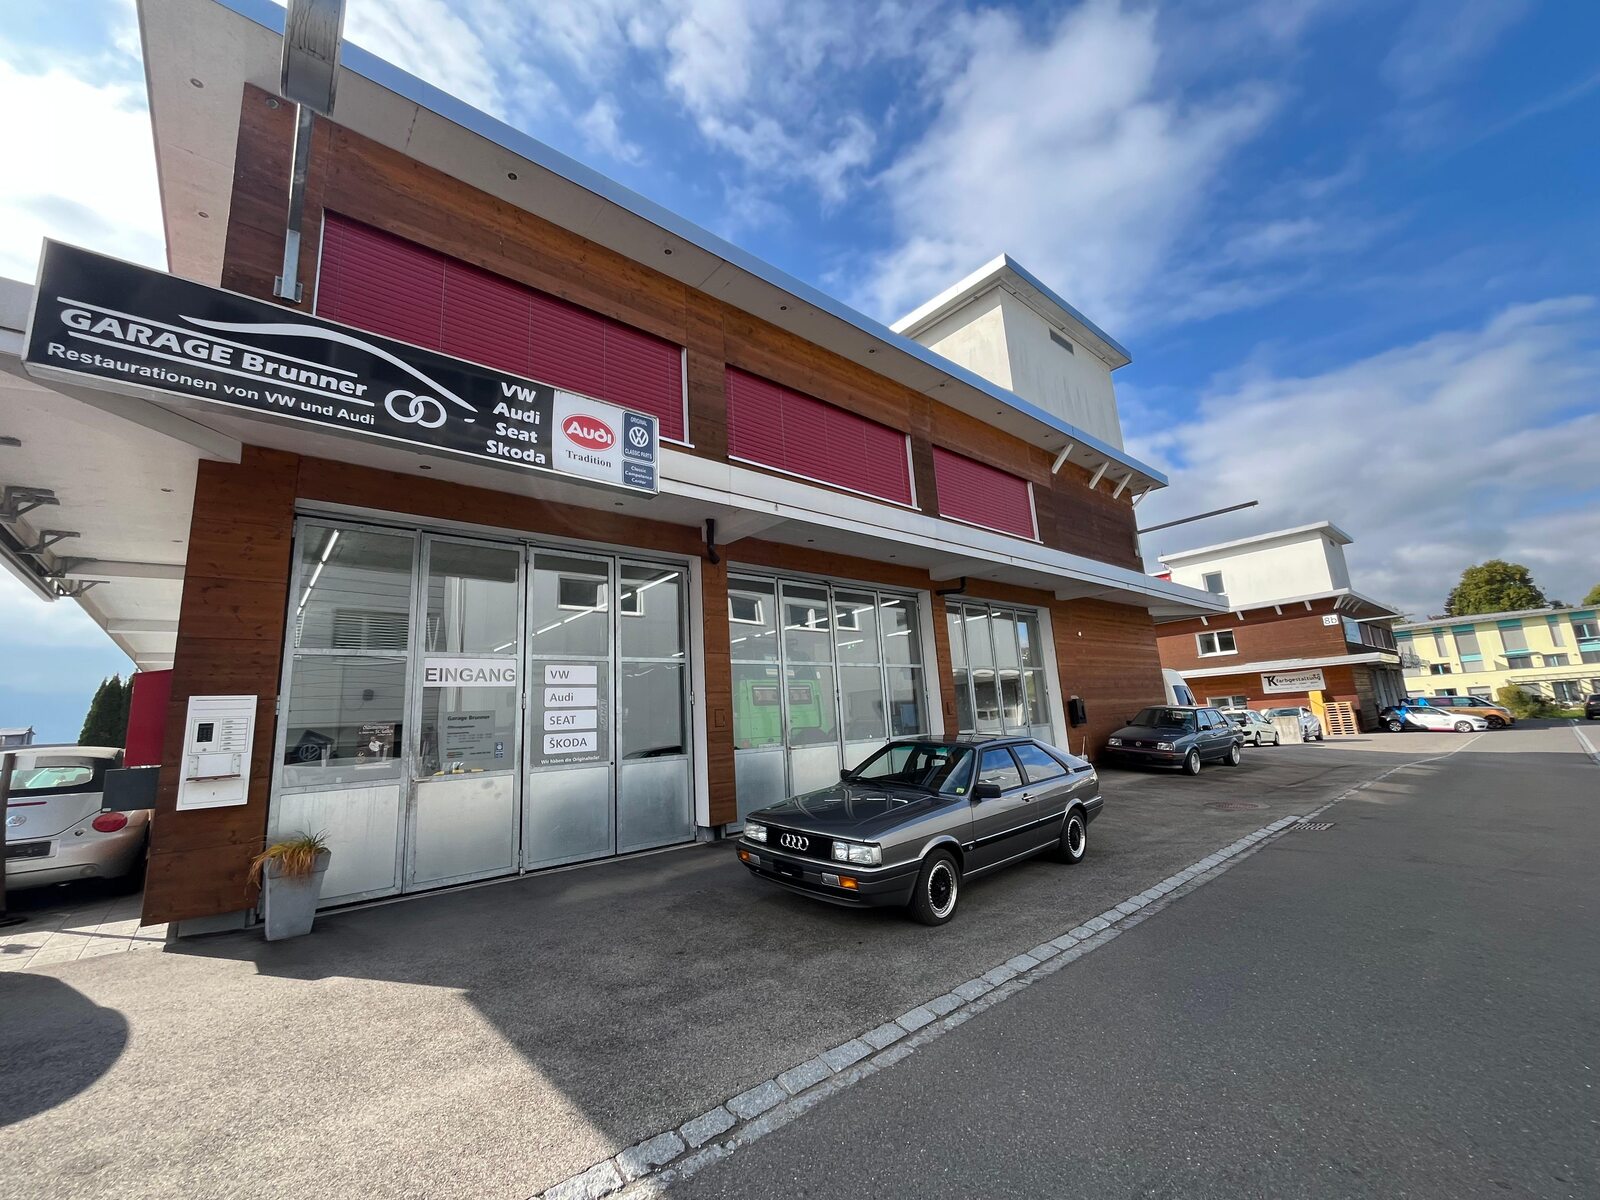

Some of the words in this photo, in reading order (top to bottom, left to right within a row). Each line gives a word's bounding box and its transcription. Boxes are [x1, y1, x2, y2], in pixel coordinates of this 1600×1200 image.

[60, 308, 234, 365] GARAGE
[241, 351, 368, 397] Brunner
[47, 342, 217, 391] Restaurationen
[223, 384, 259, 400] von
[264, 391, 296, 408] VW
[300, 401, 333, 416] und
[336, 407, 375, 426] Audi
[501, 381, 537, 403] VW
[492, 402, 541, 425] Audi
[630, 416, 648, 427] ORIGINAL
[495, 422, 538, 444] Seat
[566, 420, 612, 445] Audi
[485, 439, 546, 465] Skoda
[565, 449, 612, 468] Tradition
[624, 448, 640, 457] CLASSIC
[631, 465, 647, 473] Classic
[1324, 616, 1338, 625] 8b
[424, 667, 515, 682] EINGANG
[550, 670, 570, 680] VW
[550, 692, 574, 702] Audi
[549, 715, 577, 725] SEAT
[549, 737, 588, 749] ŠKODA
